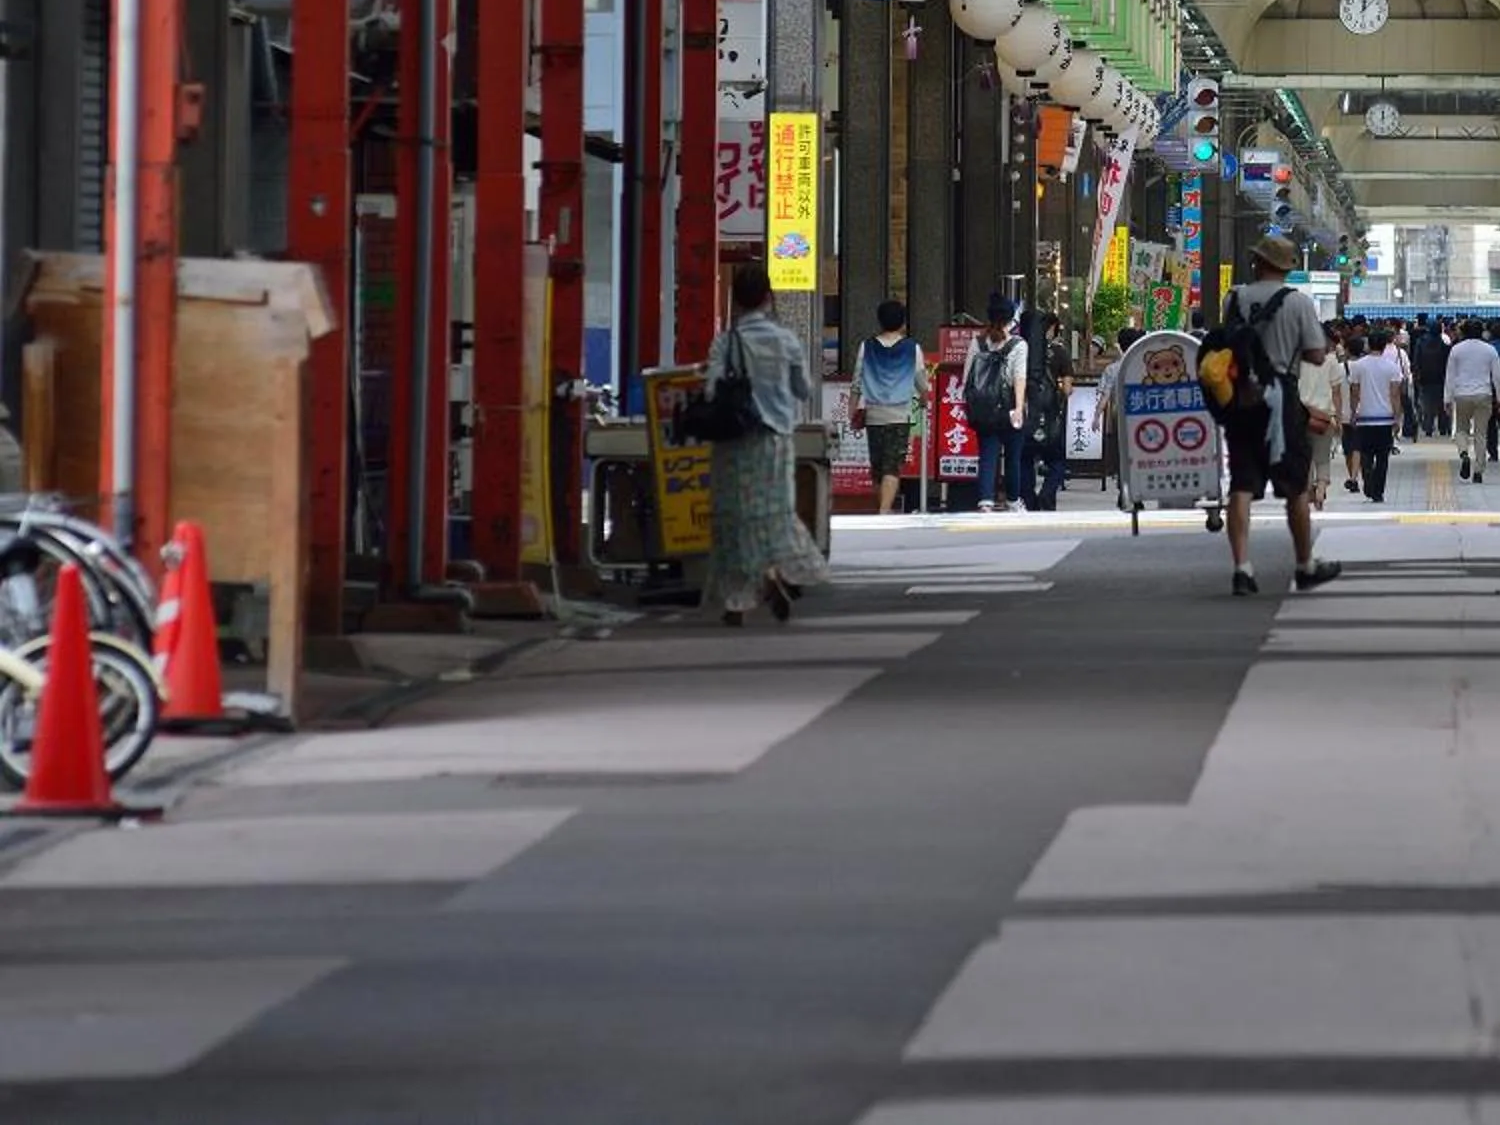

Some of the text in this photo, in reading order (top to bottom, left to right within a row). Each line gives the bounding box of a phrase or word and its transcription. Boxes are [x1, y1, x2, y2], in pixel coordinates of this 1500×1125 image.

[775, 124, 795, 220] 通行禁止
[798, 124, 811, 219] 許可車両以外
[1130, 387, 1206, 411] 歩行者専用
